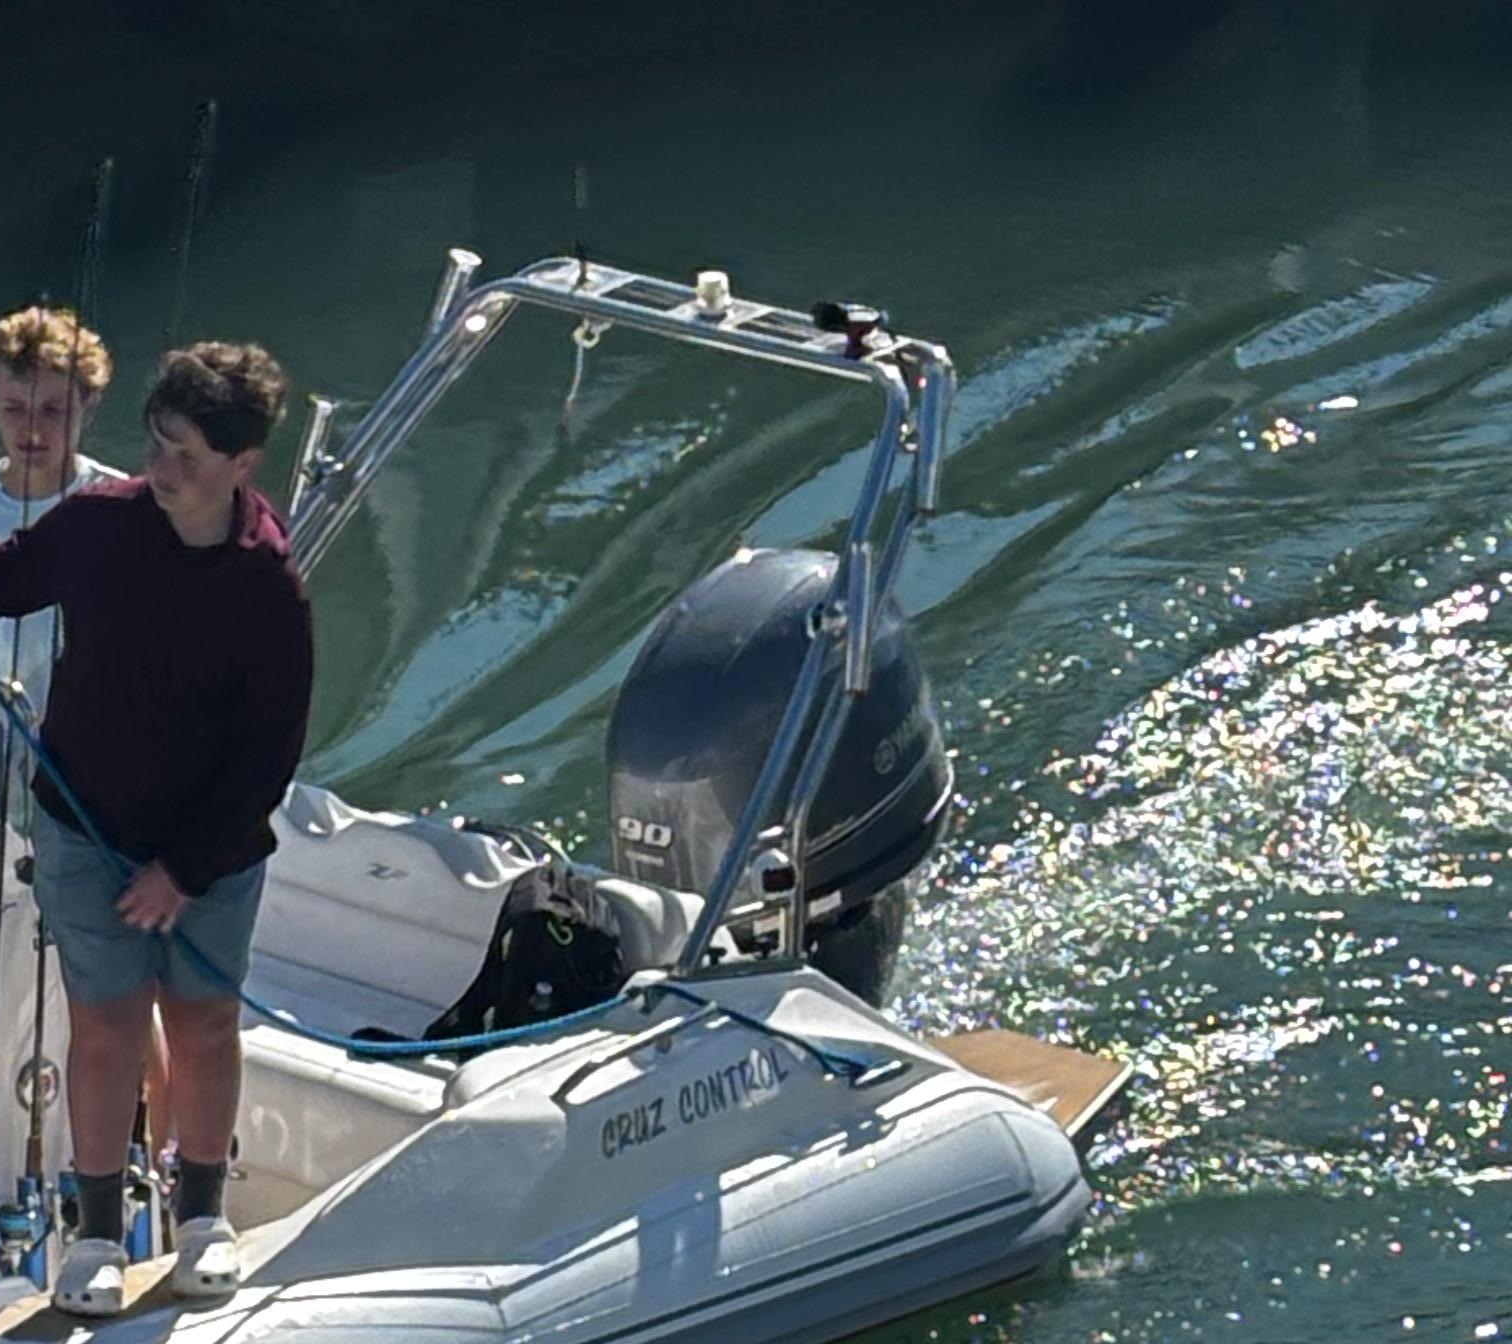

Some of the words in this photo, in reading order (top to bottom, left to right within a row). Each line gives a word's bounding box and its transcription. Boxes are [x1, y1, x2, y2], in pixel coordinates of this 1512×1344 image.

[618, 816, 672, 848] 90
[601, 1098, 668, 1158] CRUZ
[678, 1047, 790, 1125] CONTROL
